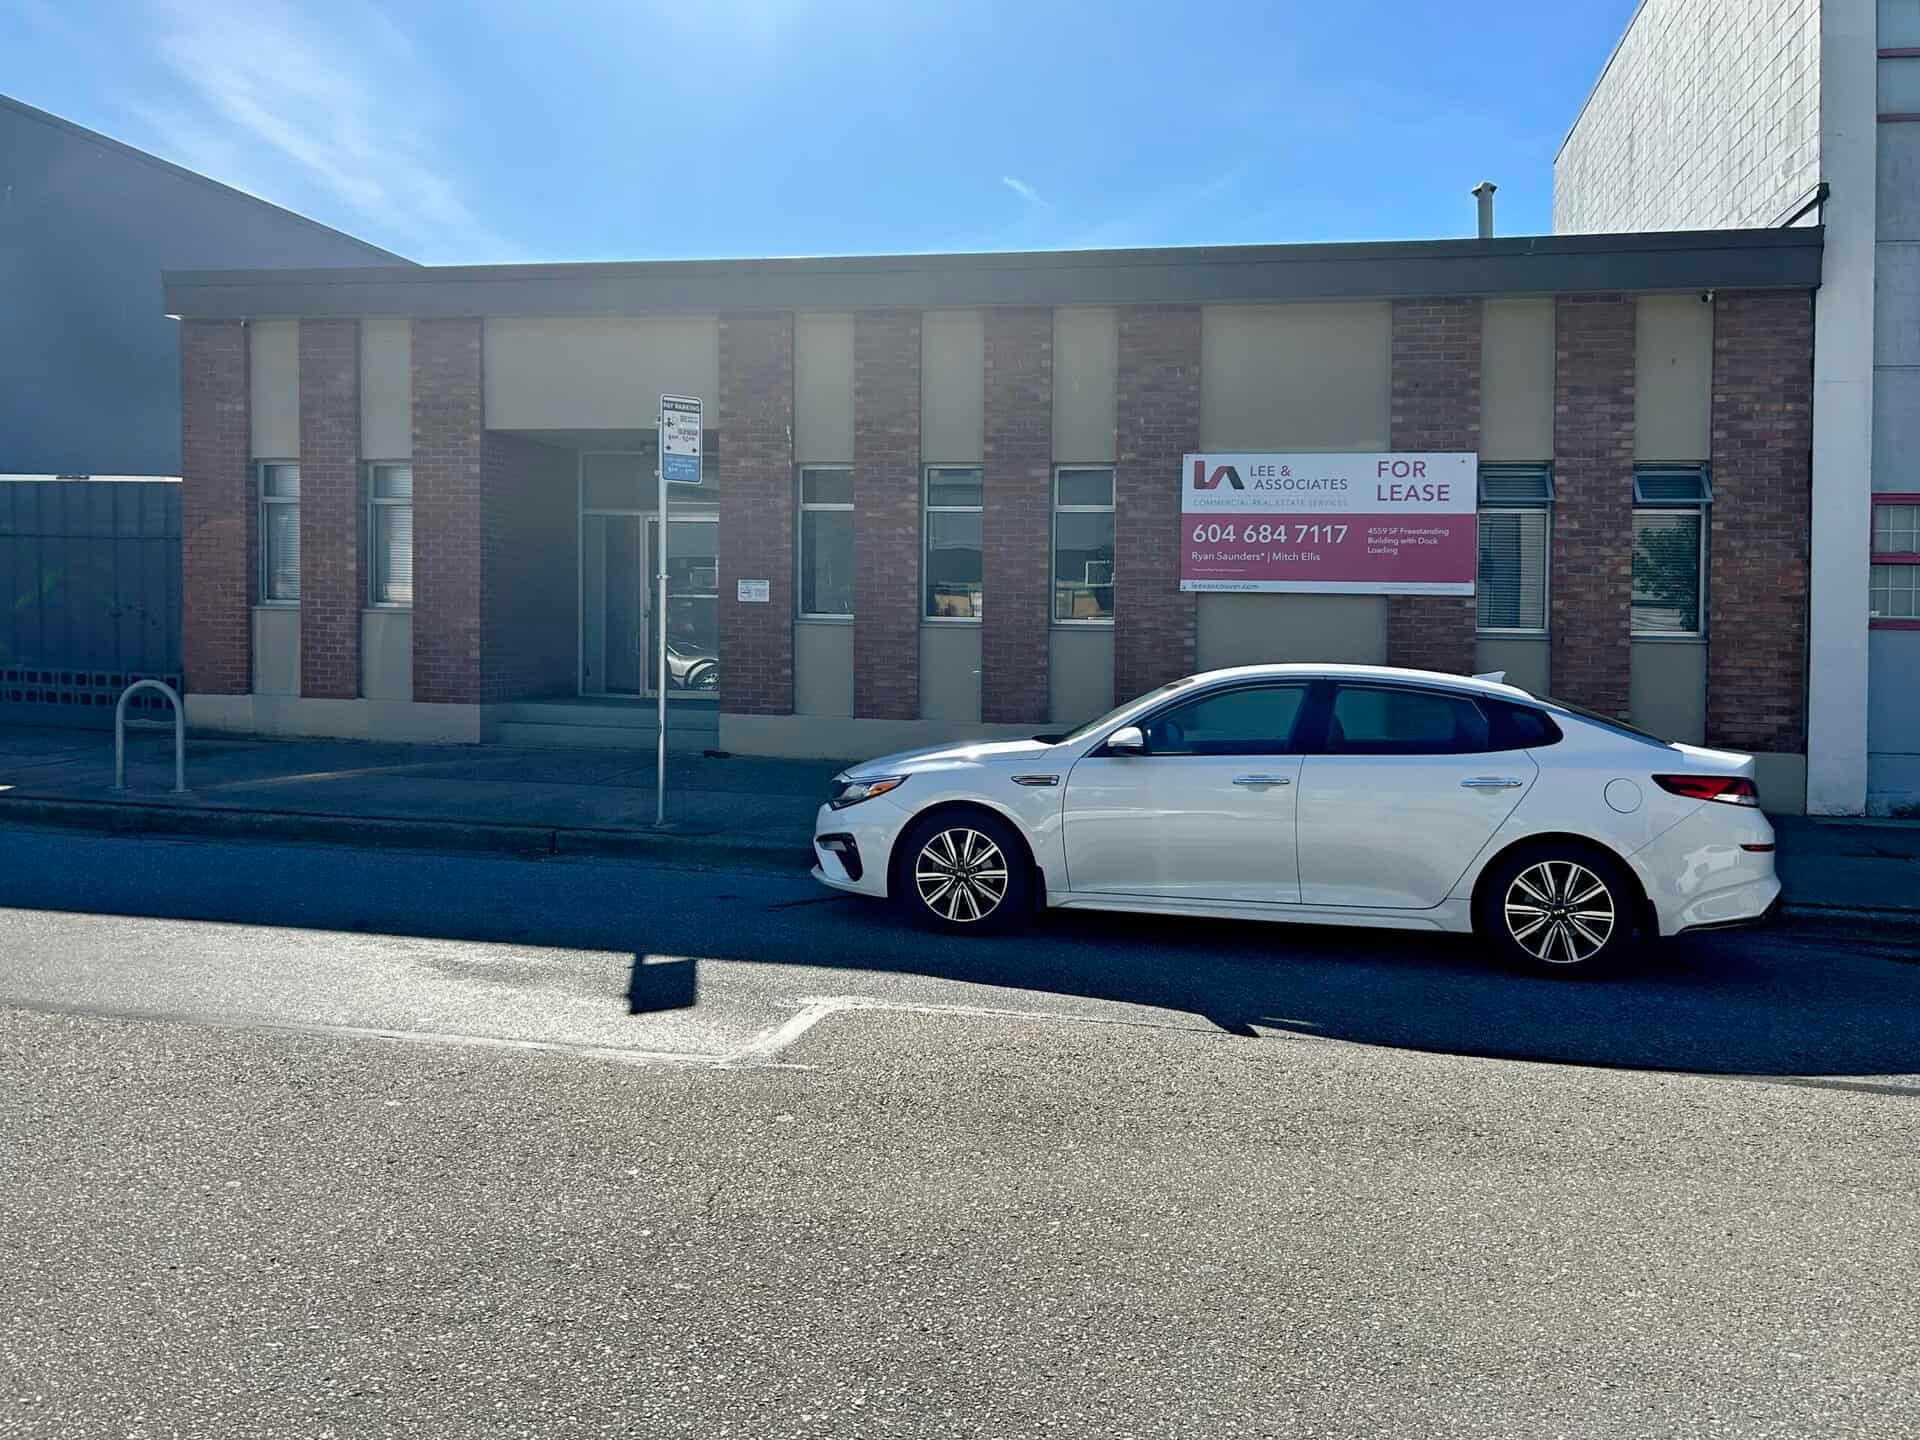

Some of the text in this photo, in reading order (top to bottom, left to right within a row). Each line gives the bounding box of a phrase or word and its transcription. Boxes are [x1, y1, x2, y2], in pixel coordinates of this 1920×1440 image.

[1250, 465, 1291, 477] LEE &
[1378, 461, 1426, 478] FOR
[1254, 479, 1348, 490] ASSOCIATES
[1377, 484, 1450, 501] LEASE
[1192, 524, 1348, 543] 604 684 7117
[1400, 527, 1449, 536] Freestanding
[1367, 537, 1399, 546] Building
[1418, 537, 1438, 545] Dock
[1367, 546, 1398, 555] Loading
[1191, 551, 1215, 562] Ryan
[1272, 551, 1299, 561] Mitch
[1301, 551, 1321, 561] Ellis
